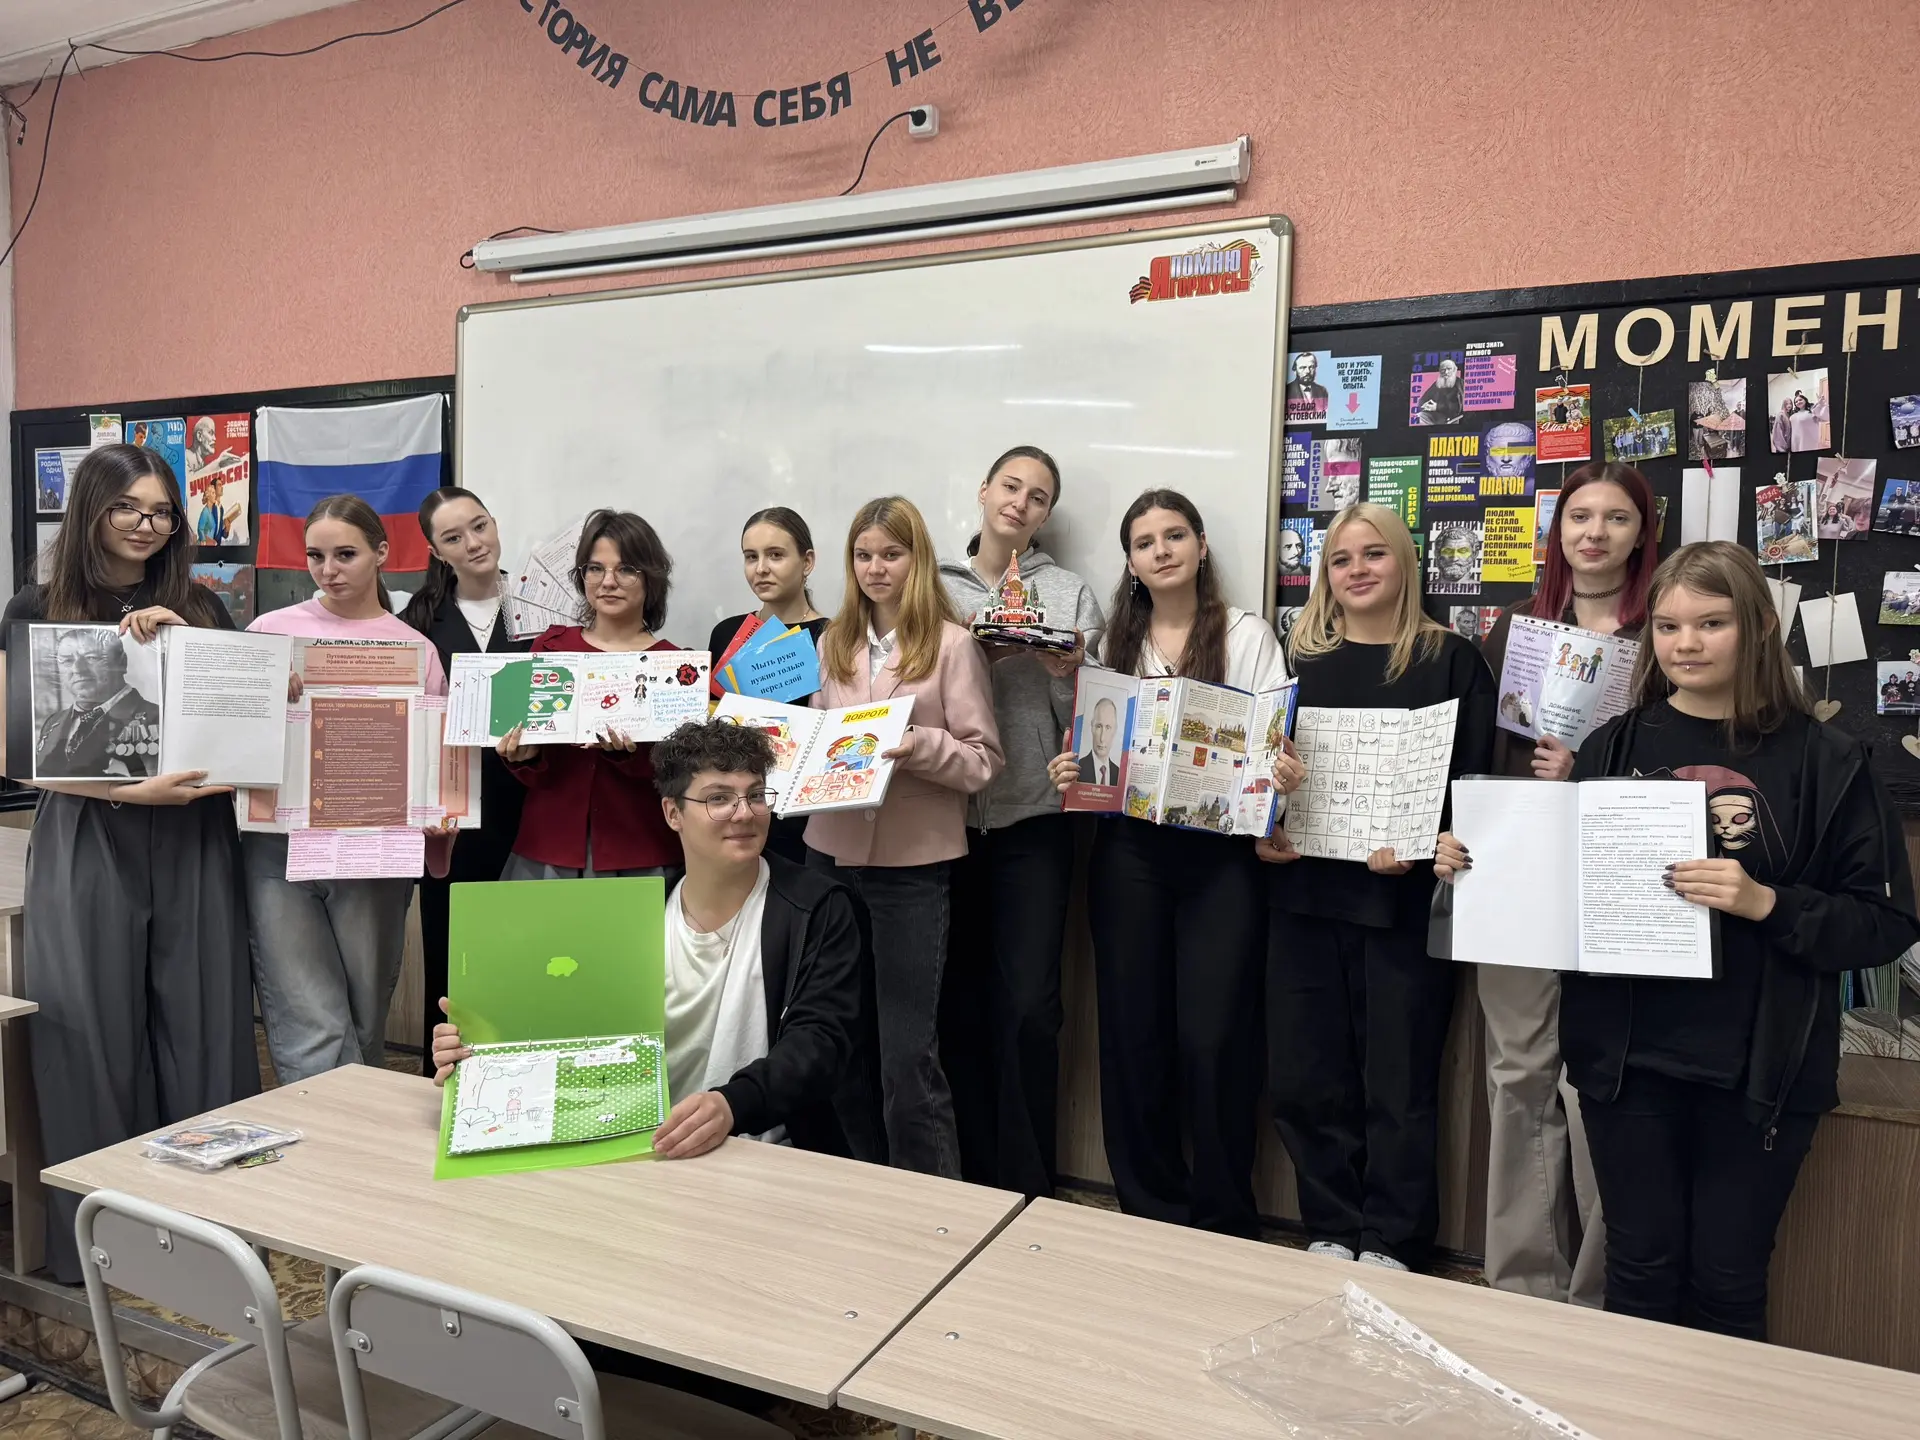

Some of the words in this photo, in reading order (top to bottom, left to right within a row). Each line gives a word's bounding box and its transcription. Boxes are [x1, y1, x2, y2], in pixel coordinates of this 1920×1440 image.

[639, 72, 736, 127] САМА
[754, 72, 851, 127] СЕБЯ
[886, 28, 941, 87] НЕ
[1538, 287, 1920, 372] МОМЕН
[1336, 362, 1348, 370] ВОТ
[1342, 376, 1349, 384] НЕ
[1284, 409, 1327, 421] ОСТОЕВСКИЙ
[1284, 444, 1304, 452] ТАЕМ,
[1429, 436, 1479, 458] ПЛАТОН
[1479, 476, 1525, 496] ПЛАТОН
[1282, 489, 1296, 497] РНО
[1485, 526, 1497, 534] БЫ
[1498, 526, 1526, 534] ЛУЧШЕ,
[1427, 583, 1480, 594] ГЕРАКЛИТ
[750, 659, 776, 672] Мыть
[776, 652, 797, 664] руки
[1618, 657, 1636, 665] ПИТО
[750, 672, 776, 686] нужно
[778, 661, 805, 676] только
[760, 682, 784, 694] перед
[841, 708, 890, 724] ДОБРОТА
